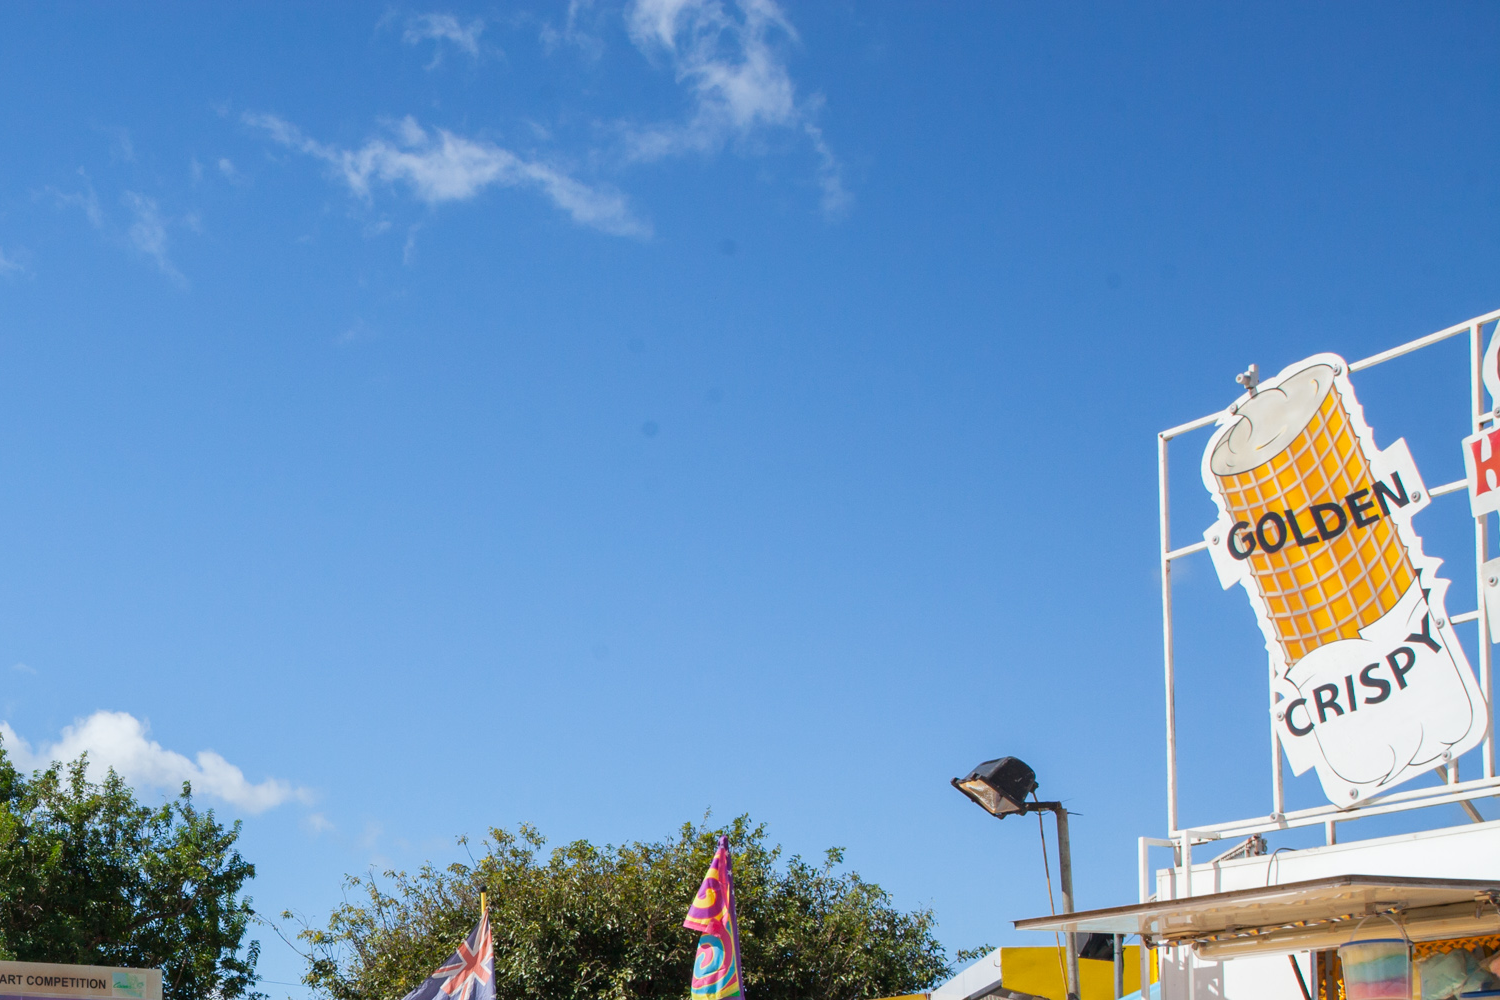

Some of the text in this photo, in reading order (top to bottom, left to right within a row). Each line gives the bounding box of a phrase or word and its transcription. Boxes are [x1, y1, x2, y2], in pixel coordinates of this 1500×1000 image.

[1227, 470, 1410, 561] GOLDEN
[1284, 611, 1442, 738] CRISPY
[0, 974, 23, 985] ART
[26, 975, 106, 990] COMPETITION
